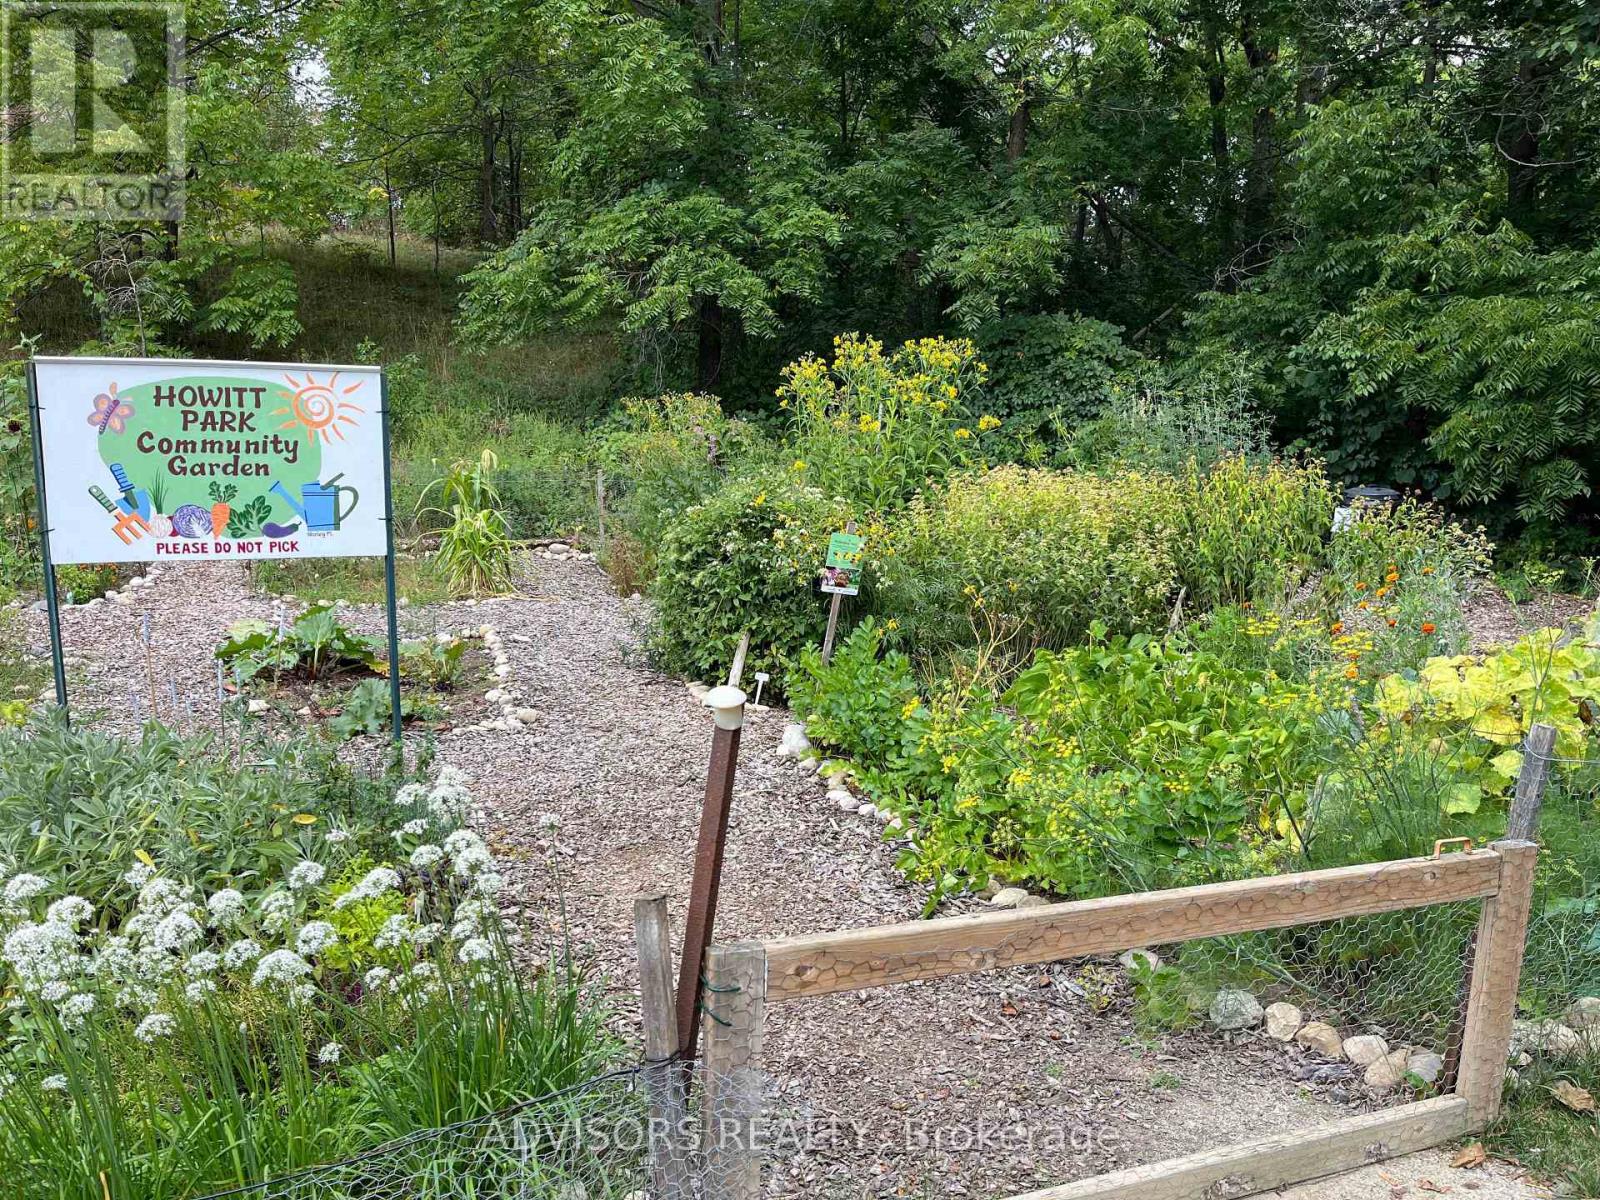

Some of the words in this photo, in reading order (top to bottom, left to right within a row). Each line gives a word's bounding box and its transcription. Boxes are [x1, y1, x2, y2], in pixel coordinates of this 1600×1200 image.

[153, 385, 267, 408] HOWITT
[181, 411, 257, 433] PARK
[136, 431, 299, 464] Community
[168, 455, 270, 476] Garden
[156, 542, 208, 555] PLEASE
[214, 542, 232, 554] DO
[238, 541, 264, 554] NOT
[270, 541, 301, 554] PICK
